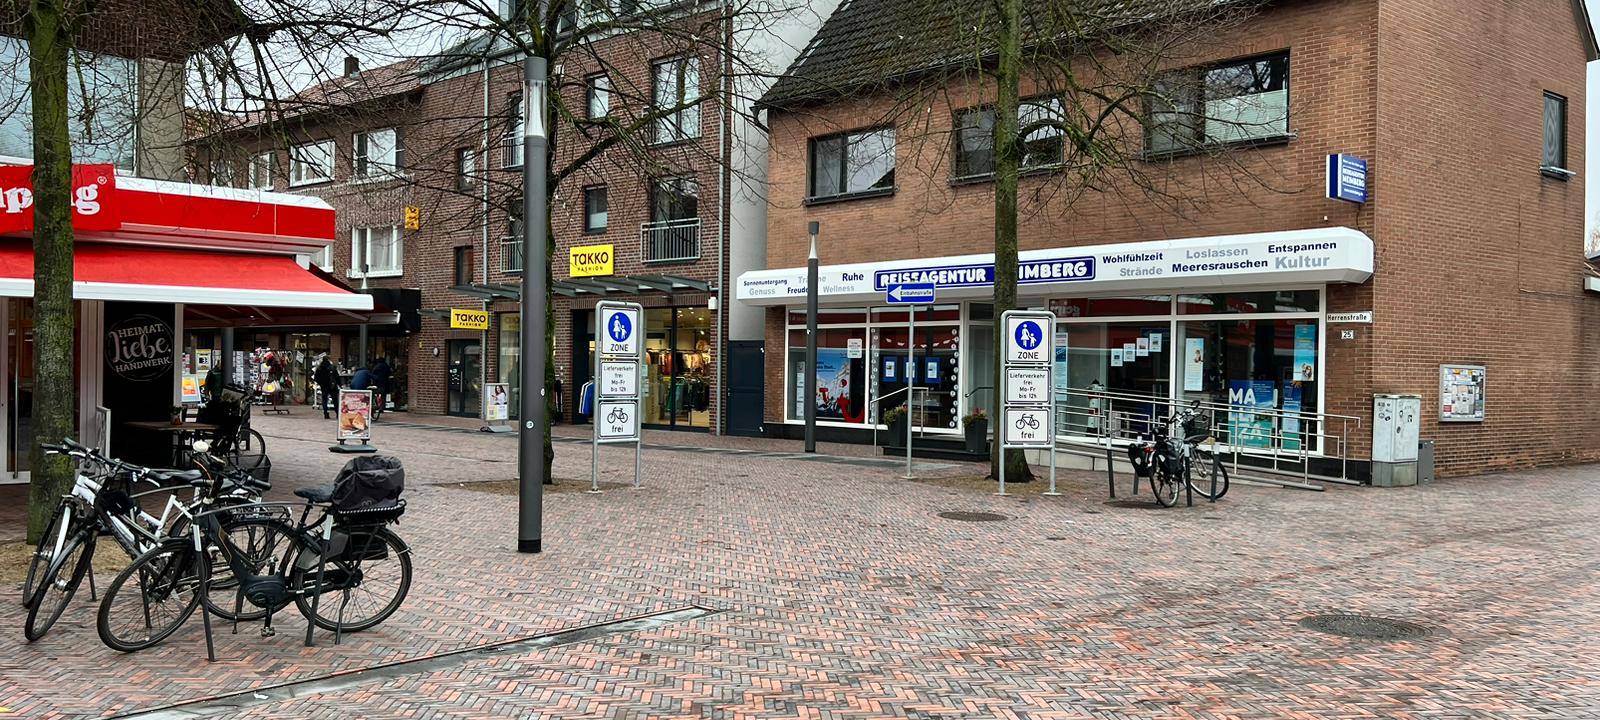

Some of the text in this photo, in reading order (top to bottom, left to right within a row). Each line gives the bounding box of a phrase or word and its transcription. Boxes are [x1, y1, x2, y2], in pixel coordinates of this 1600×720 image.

[1268, 241, 1337, 254] Entspannen
[1186, 246, 1248, 260] Loslassen
[1102, 252, 1163, 264] Wohlfühlzeit
[1275, 254, 1330, 269] Kultur
[1018, 261, 1088, 279] IMBERG
[1172, 258, 1268, 273] Meeresrauschen
[1119, 265, 1163, 277] Strände
[842, 272, 865, 282] Ruhe
[743, 279, 788, 287] Sonnenuntergang
[749, 287, 776, 296] Genuss
[823, 285, 855, 293] Wellness
[1327, 313, 1367, 321] Herrenstraße
[610, 344, 629, 352] ZONE
[1017, 352, 1039, 360] ZONE
[611, 425, 624, 433] frei
[1020, 431, 1035, 439] frei
